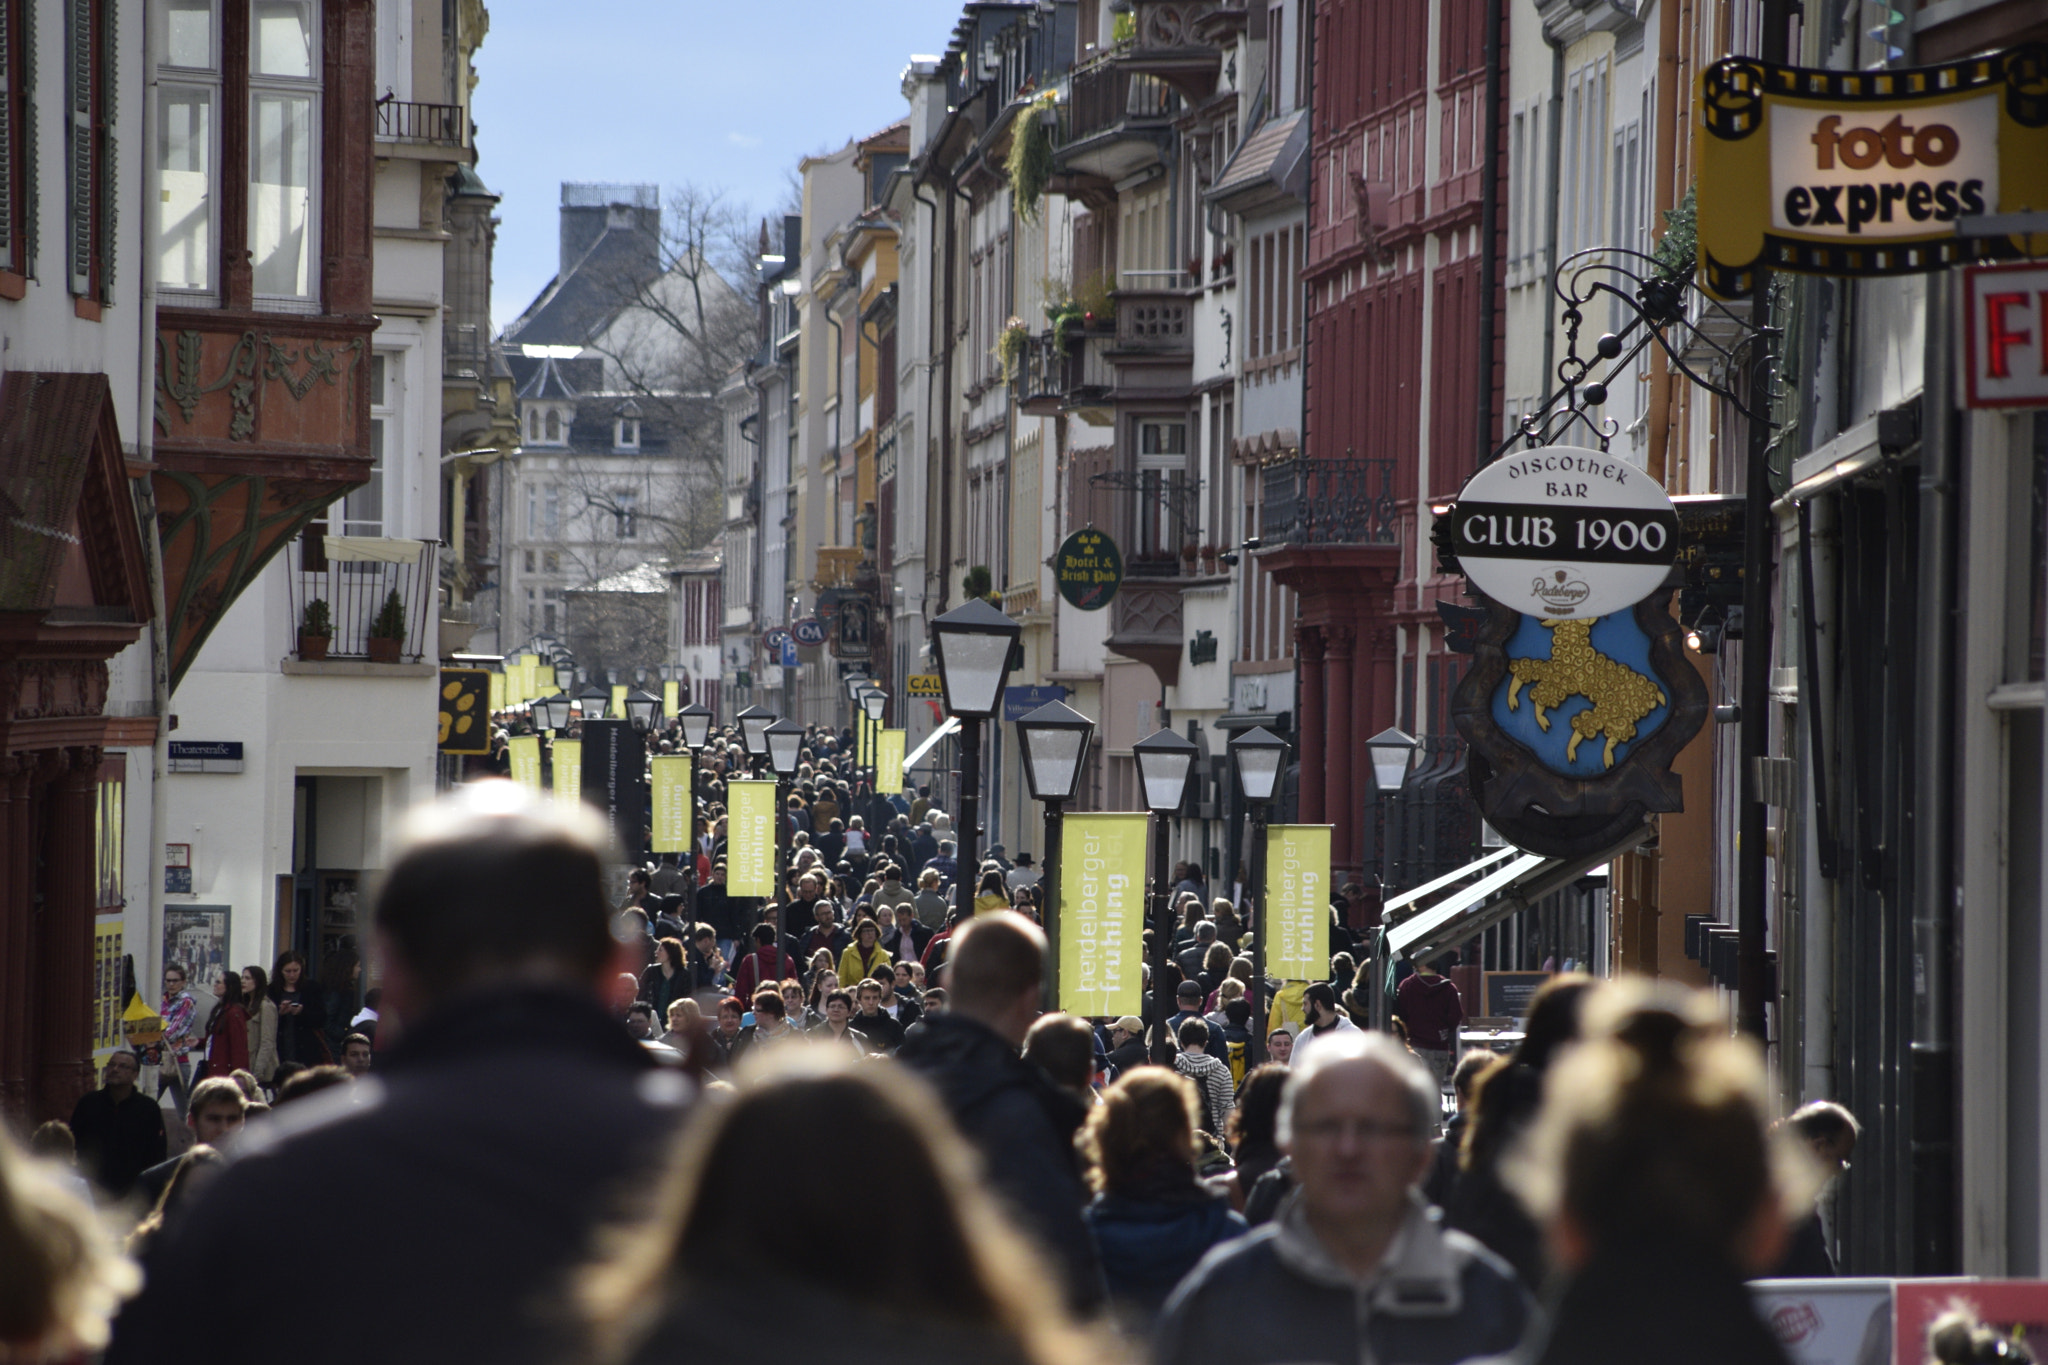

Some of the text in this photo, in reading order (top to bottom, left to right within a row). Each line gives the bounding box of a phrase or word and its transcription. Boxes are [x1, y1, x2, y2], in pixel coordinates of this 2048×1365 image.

[1811, 113, 1960, 171] foto
[1785, 179, 1985, 234] express
[1546, 482, 1588, 498] BAR
[1463, 515, 1667, 551] CLUB 1900
[1061, 570, 1116, 584] Irish Pub
[1065, 556, 1113, 568] Hotel &
[1531, 577, 1590, 604] Radeberger
[910, 677, 941, 690] CAL
[170, 743, 229, 755] Theaterstraße
[608, 727, 619, 851] Heidelberger Kunstve
[737, 790, 754, 883] heidelberger
[1075, 831, 1105, 992] heidelberger
[1278, 838, 1300, 962] heidelberger
[1295, 871, 1319, 962] frühling
[1099, 874, 1129, 992] frühling
